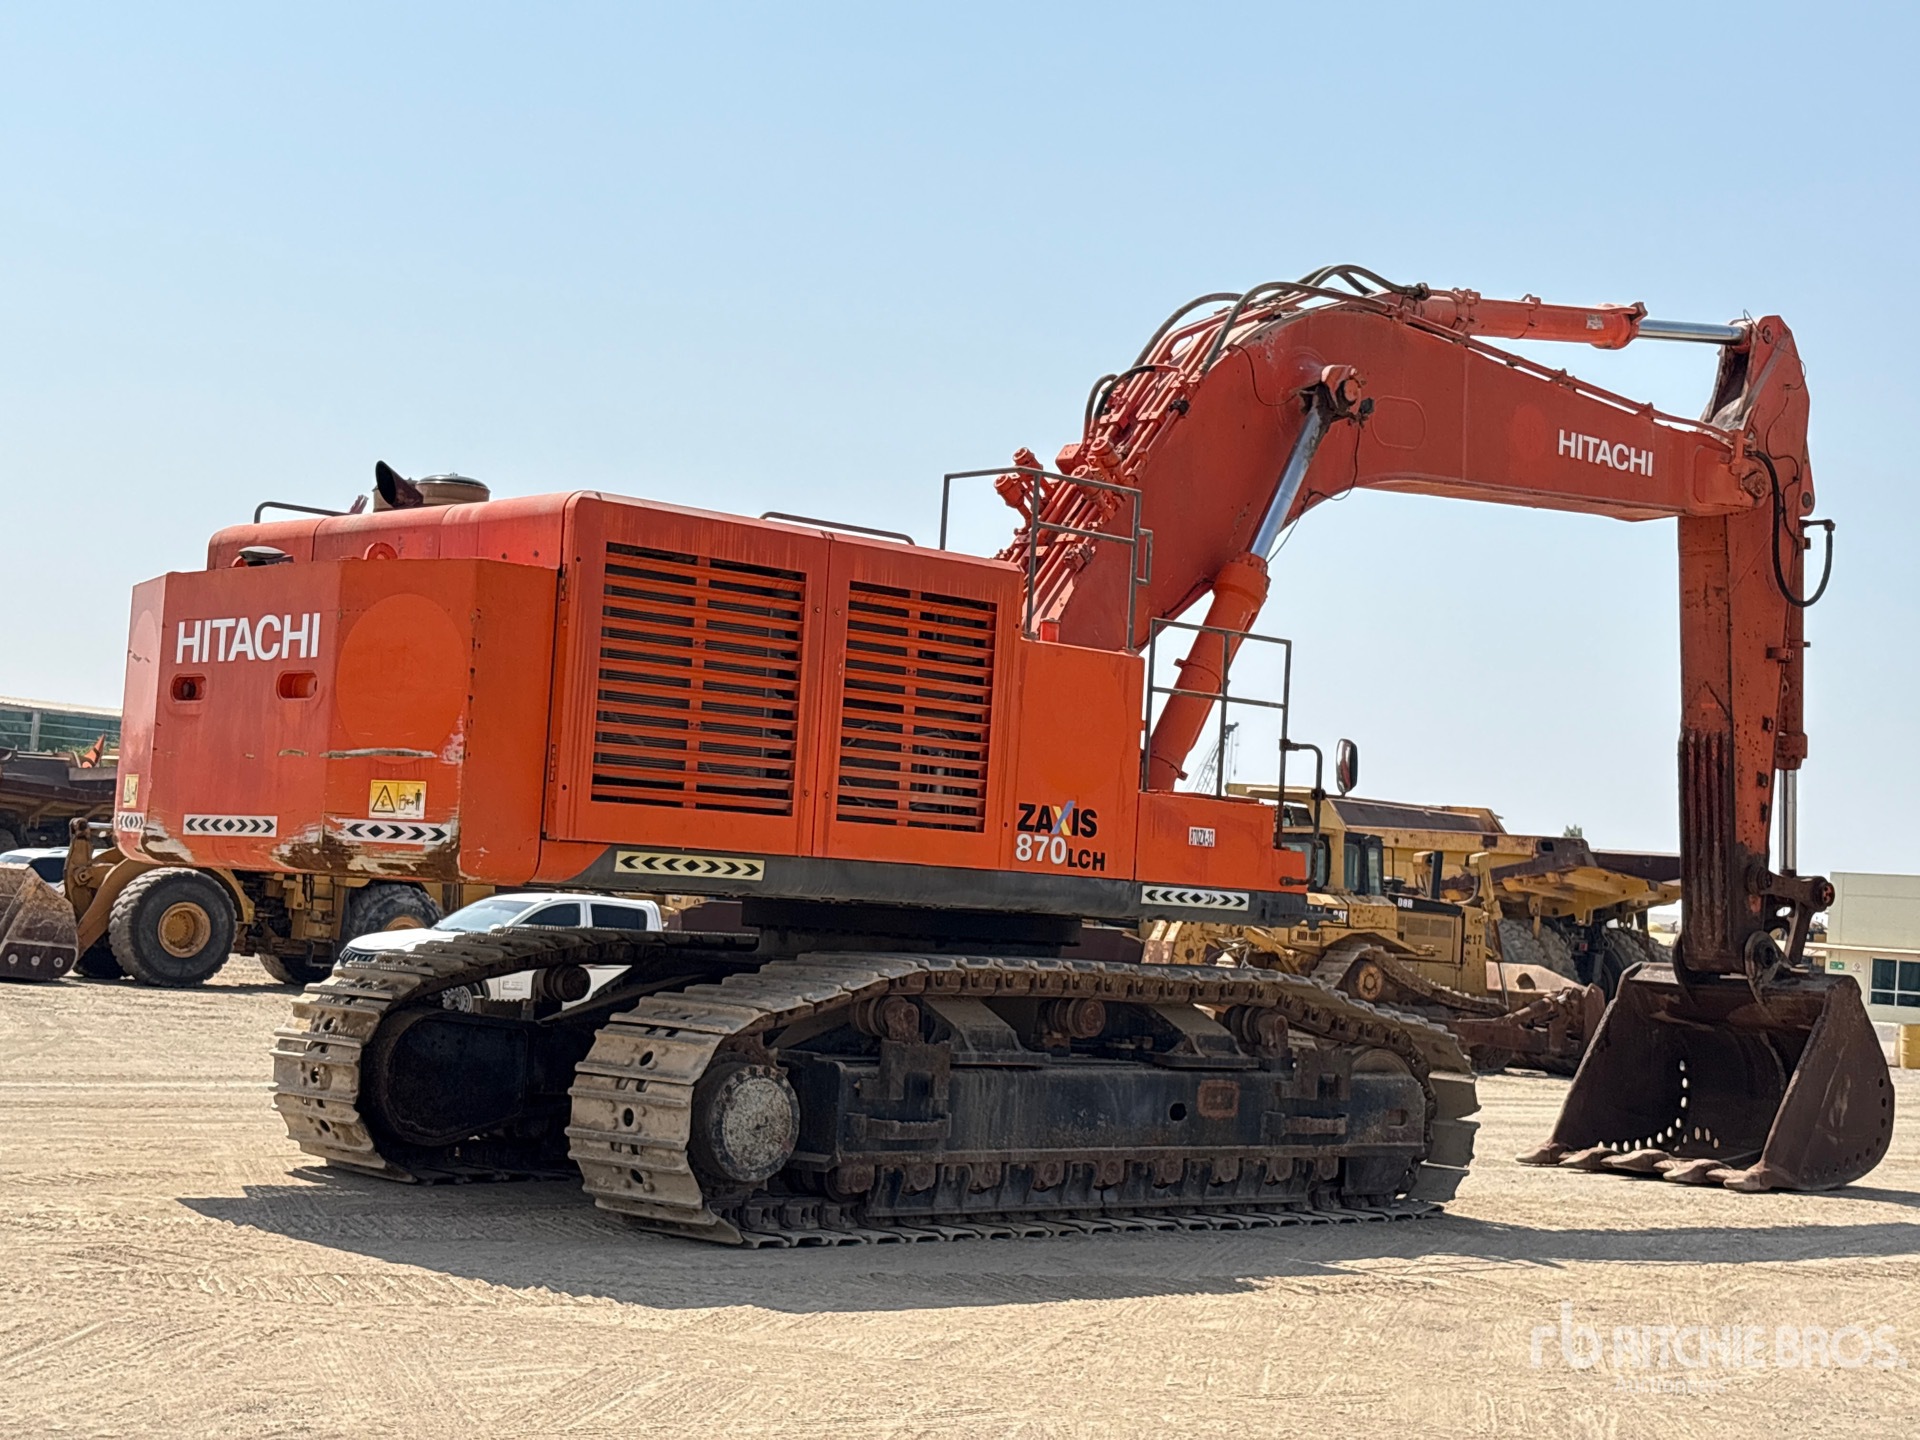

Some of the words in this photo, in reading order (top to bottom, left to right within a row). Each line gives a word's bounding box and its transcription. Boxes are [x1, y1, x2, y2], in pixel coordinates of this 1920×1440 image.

[1558, 429, 1653, 477] HITACHI
[175, 612, 321, 664] HITACHI
[1017, 800, 1097, 838] ZAXIS
